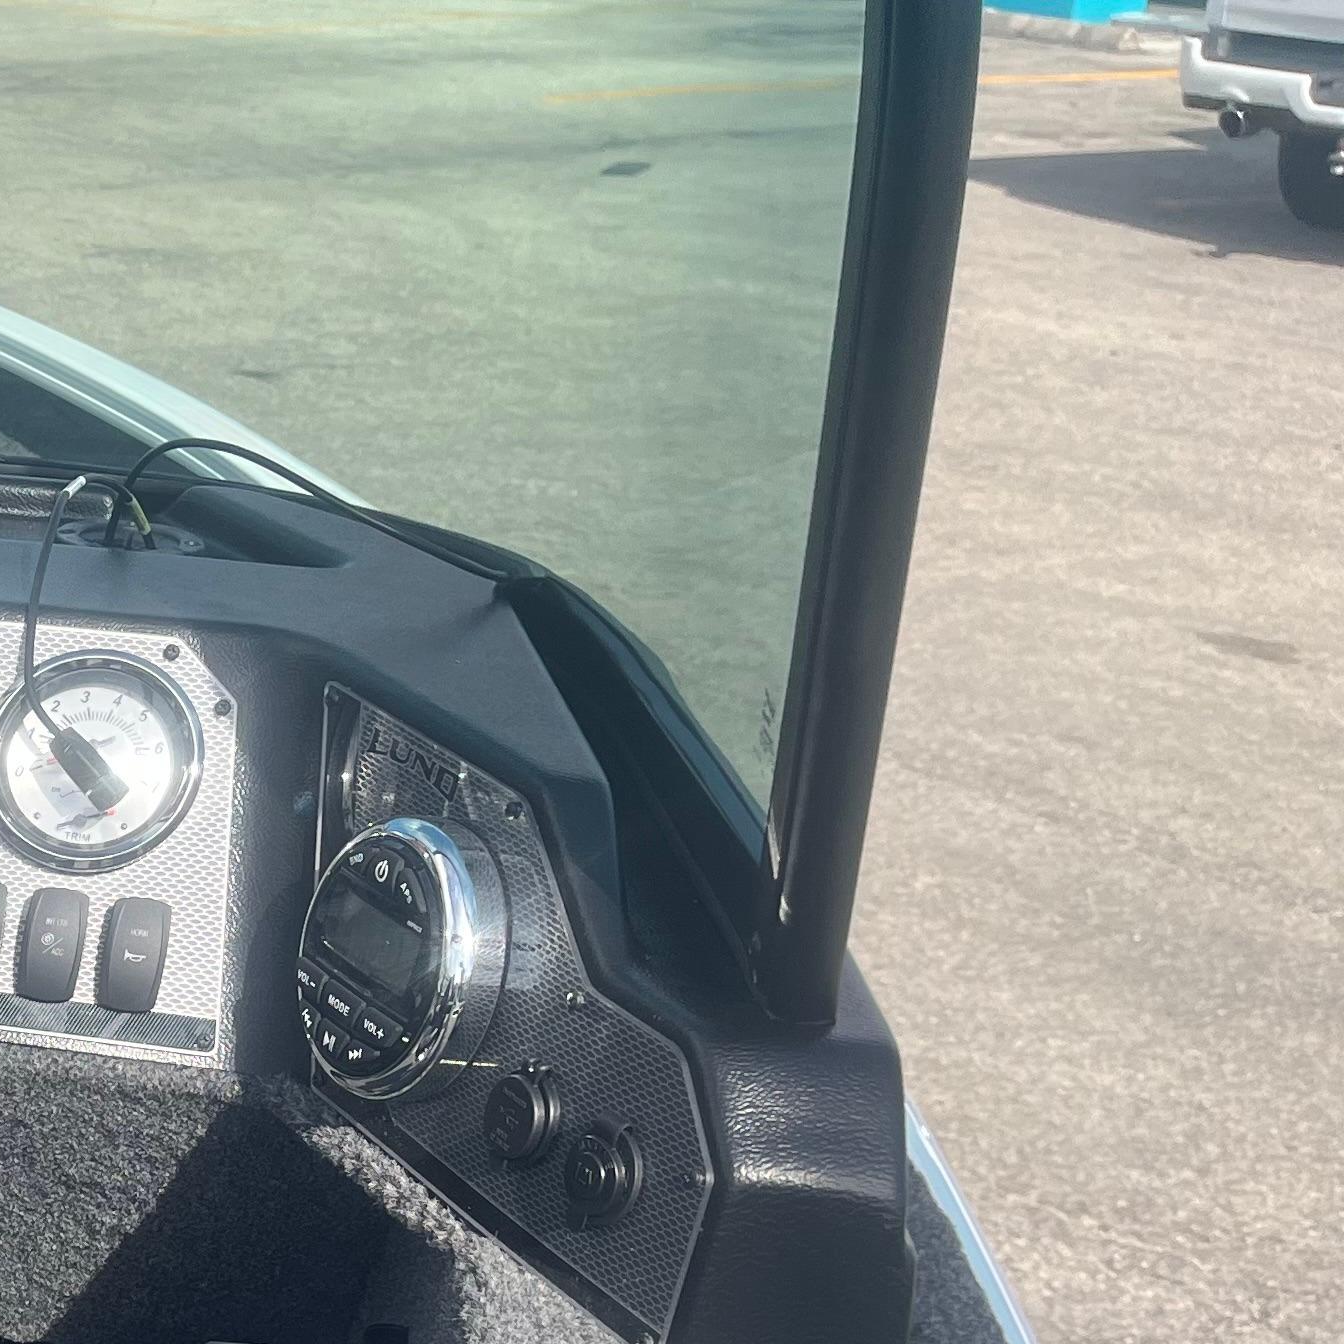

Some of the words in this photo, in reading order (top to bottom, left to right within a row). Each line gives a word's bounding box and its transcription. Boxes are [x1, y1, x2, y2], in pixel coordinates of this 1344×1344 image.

[80, 691, 91, 703] 3
[113, 694, 123, 707] 4
[51, 700, 60, 713] 2
[139, 709, 150, 722] 5
[155, 743, 165, 754] 6
[367, 727, 460, 801] LUND
[15, 767, 25, 777] 0
[65, 832, 91, 842] TRIM
[328, 994, 351, 1016] MODE
